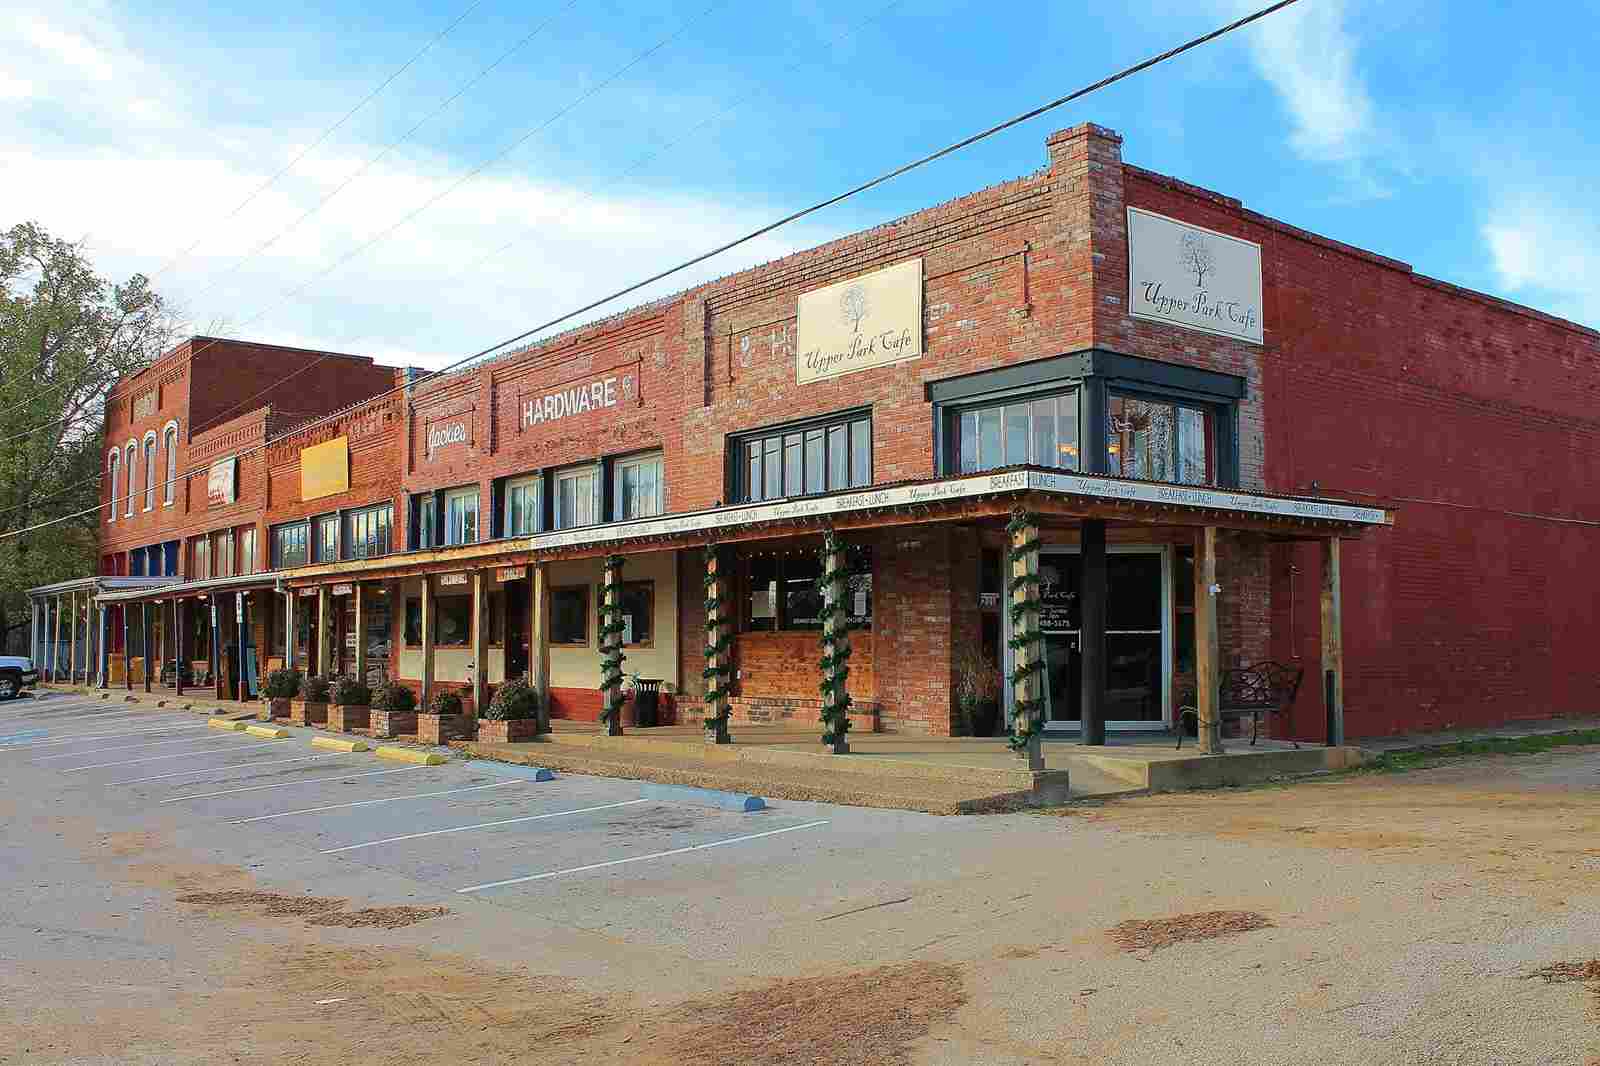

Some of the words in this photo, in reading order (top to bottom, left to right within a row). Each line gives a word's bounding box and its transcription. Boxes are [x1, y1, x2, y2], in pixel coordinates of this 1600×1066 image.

[1141, 281, 1186, 314] Upper
[1192, 288, 1222, 320] Park
[804, 347, 844, 374] Upper
[847, 334, 876, 360] Park
[523, 377, 617, 432] HARDWARE
